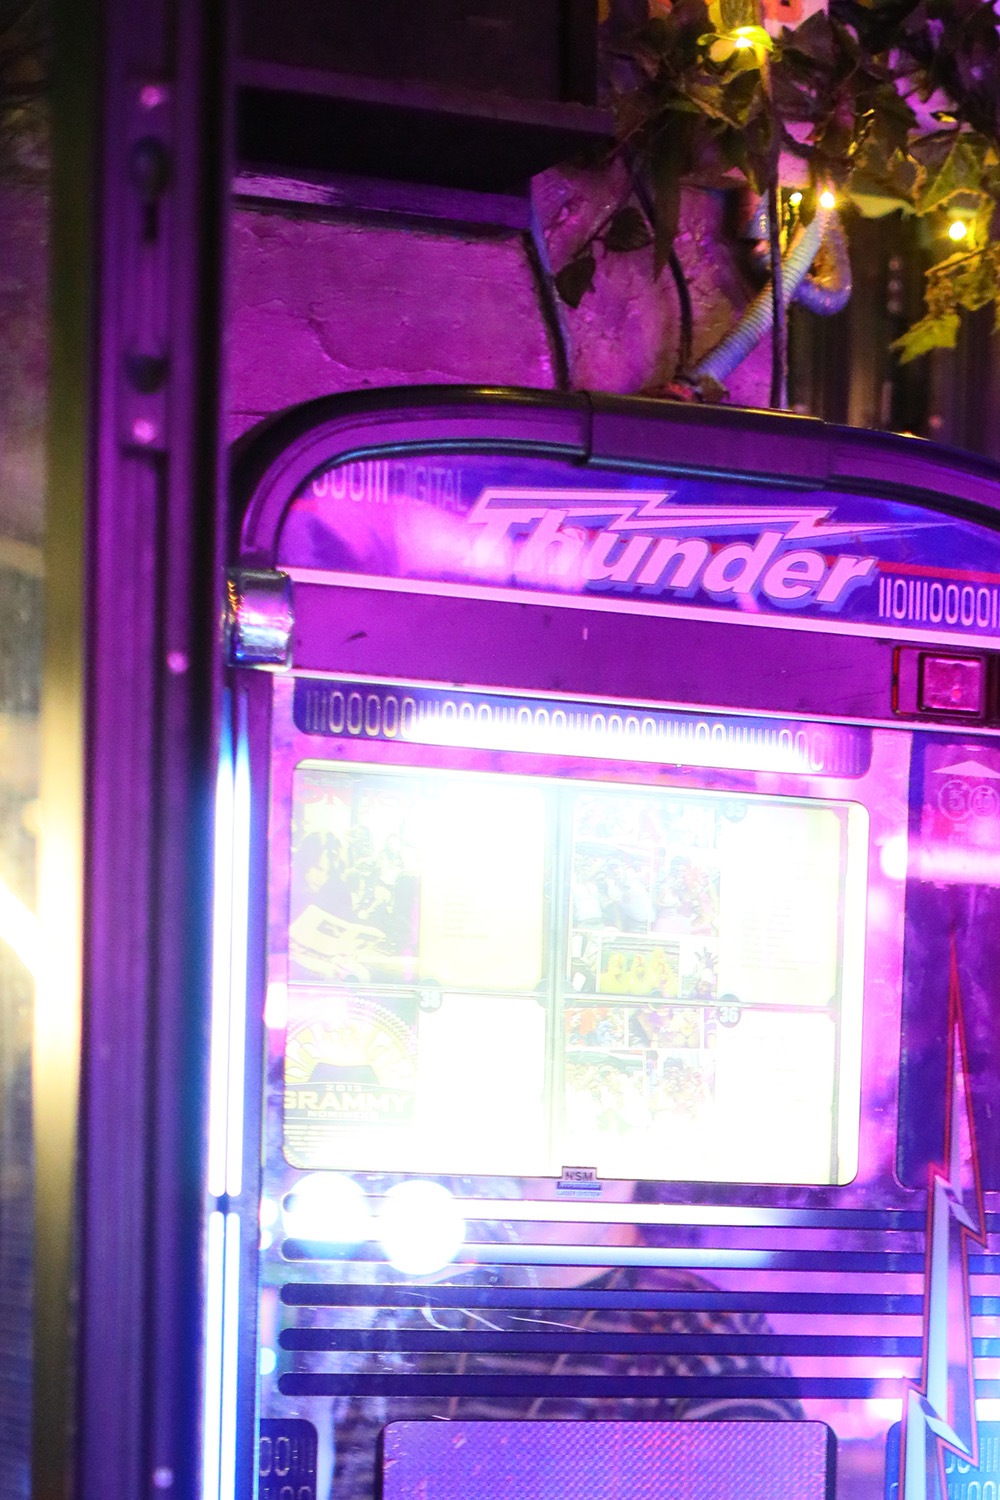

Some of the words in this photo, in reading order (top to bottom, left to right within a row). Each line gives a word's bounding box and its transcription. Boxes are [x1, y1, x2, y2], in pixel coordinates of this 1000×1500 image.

[466, 488, 880, 606] Thunder
[725, 800, 745, 818] 35
[719, 1006, 739, 1023] 36
[565, 1171, 593, 1181] NSM
